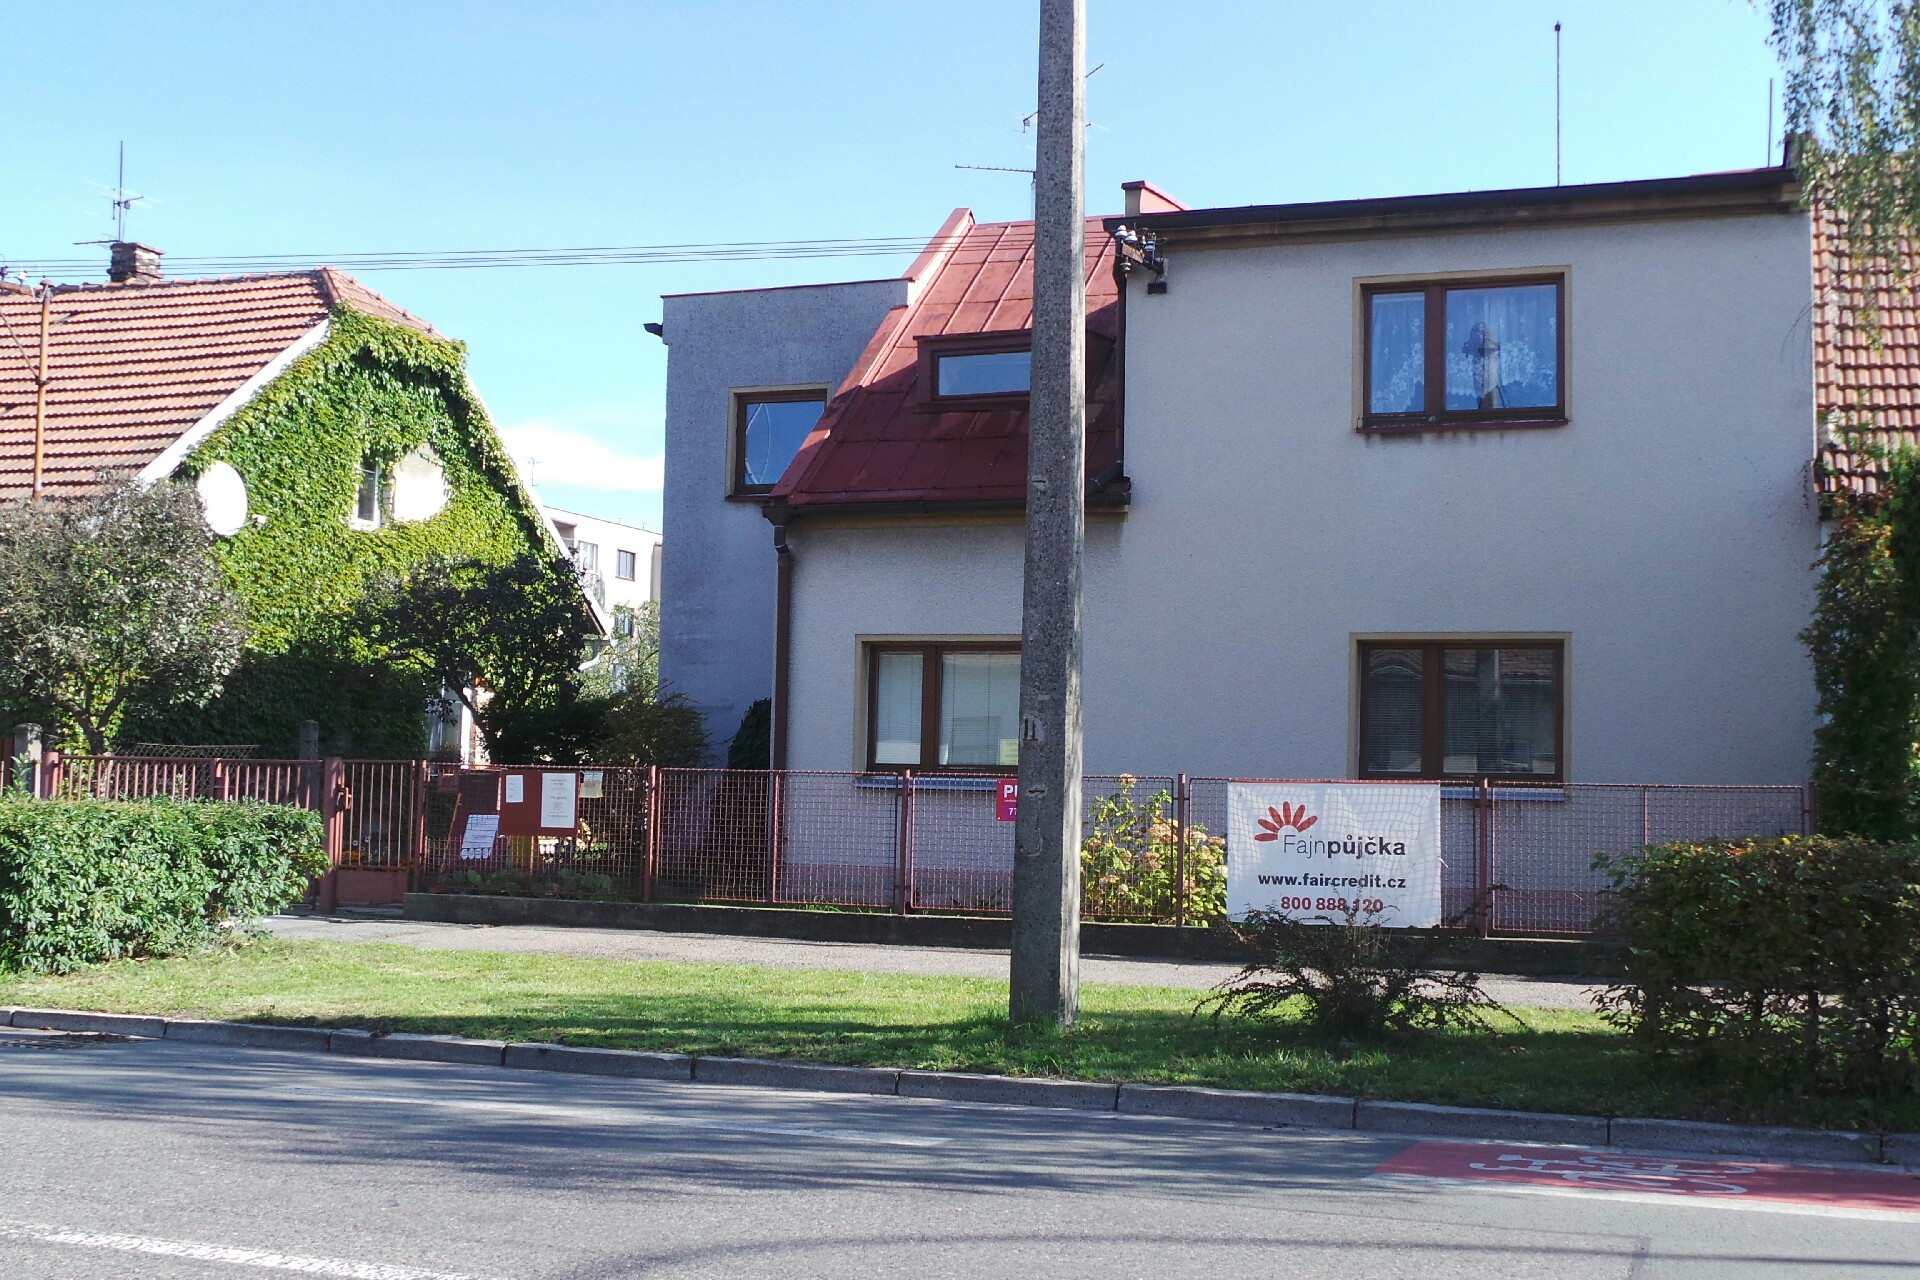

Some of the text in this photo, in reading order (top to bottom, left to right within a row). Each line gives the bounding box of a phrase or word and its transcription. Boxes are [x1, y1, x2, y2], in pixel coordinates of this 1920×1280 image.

[1283, 834, 1406, 859] Fajnpůjčka
[1258, 873, 1406, 888] www.faircredit.cz
[1280, 896, 1384, 913] 800 888 120
